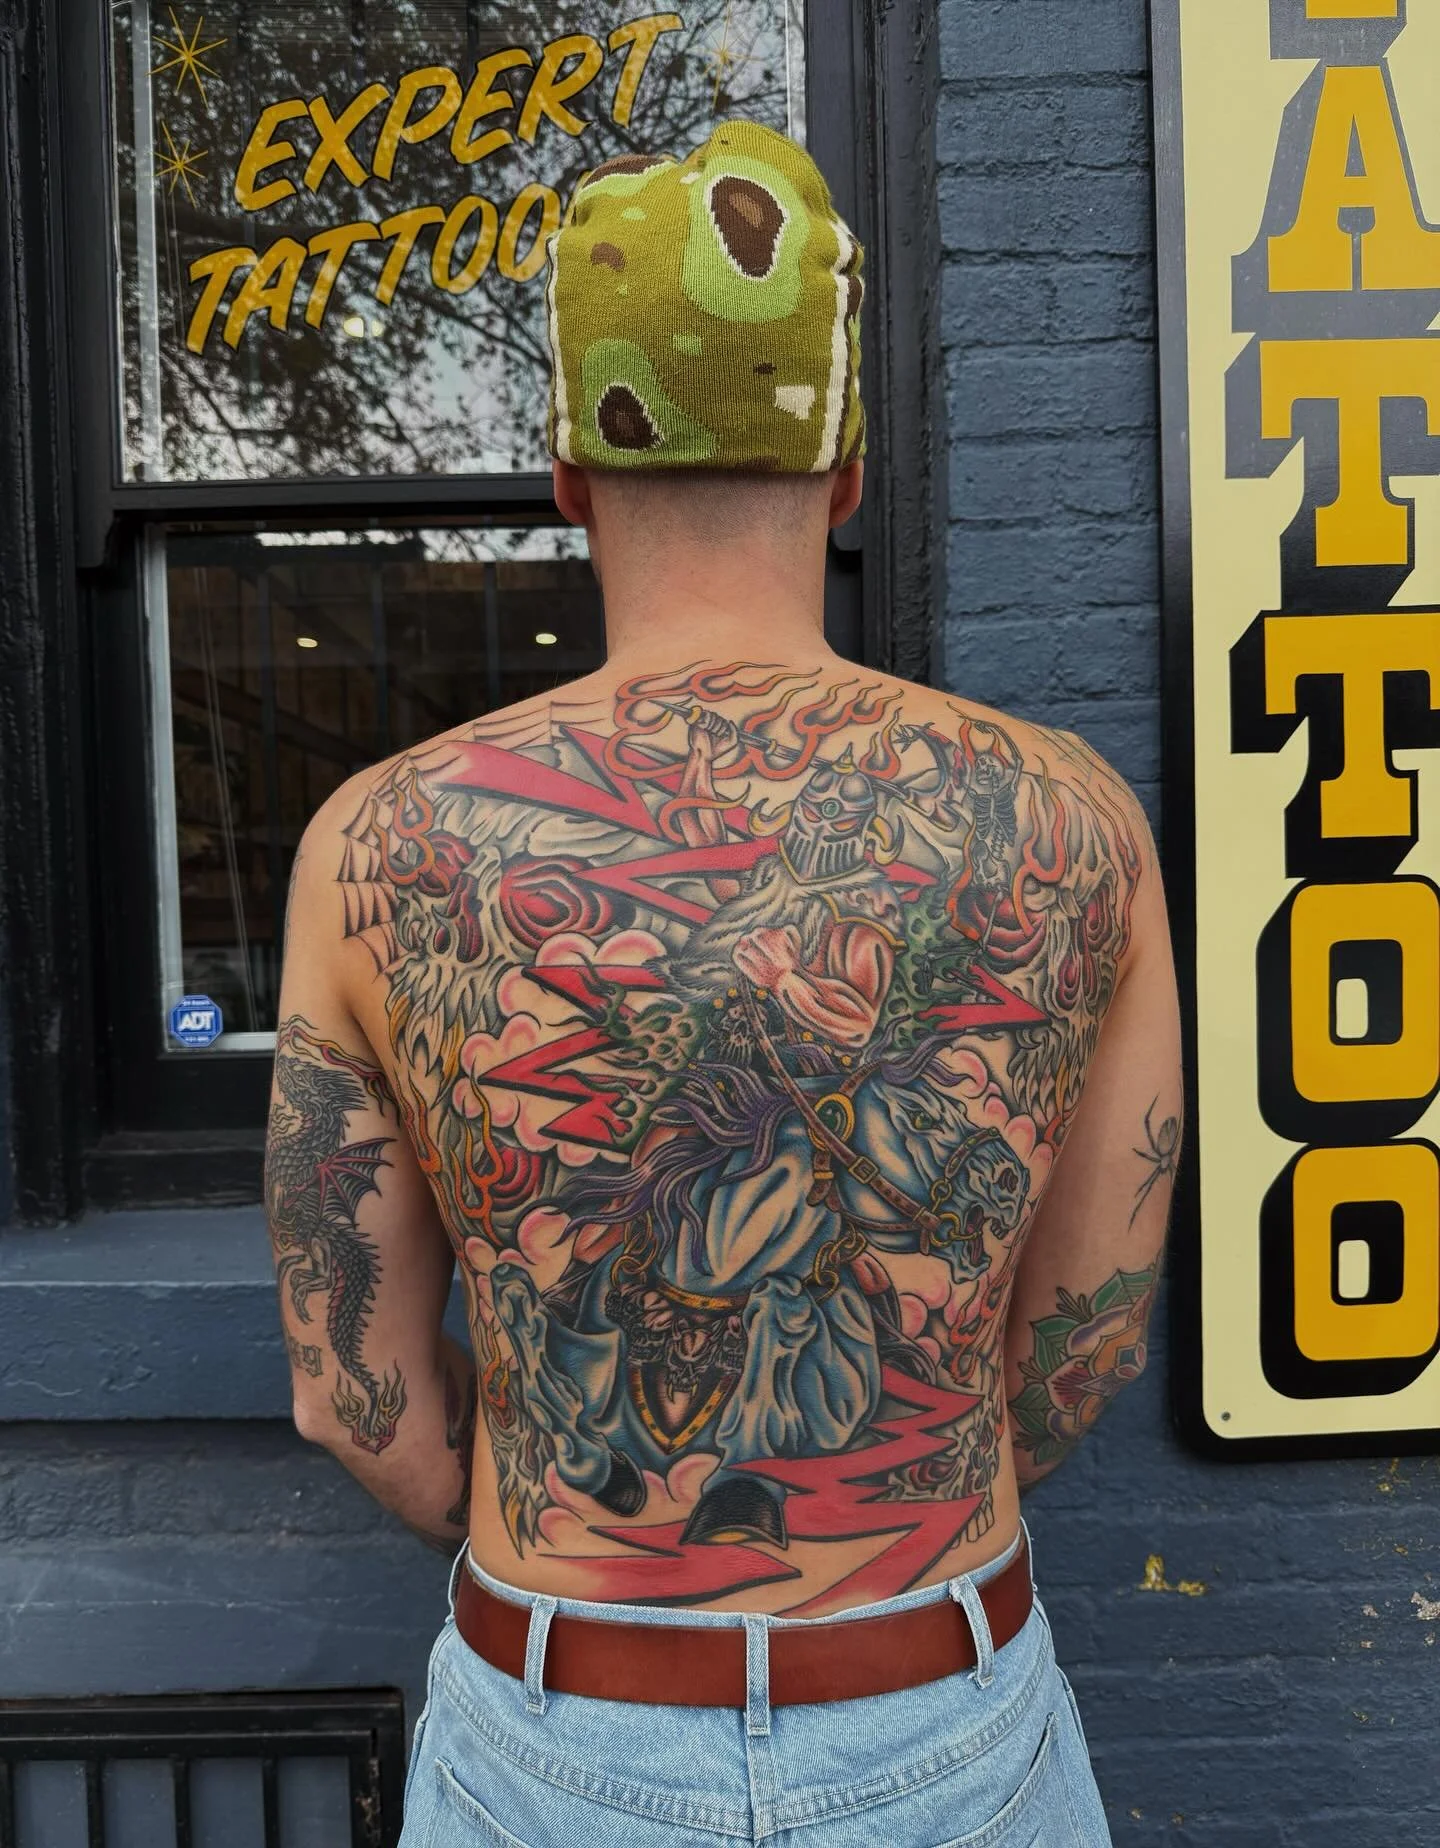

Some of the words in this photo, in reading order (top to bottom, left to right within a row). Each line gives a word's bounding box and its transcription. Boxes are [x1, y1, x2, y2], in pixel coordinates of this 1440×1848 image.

[234, 12, 685, 211] EXPERT
[1240, 0, 1440, 1382] ATTOO
[178, 1010, 215, 1031] ADT
